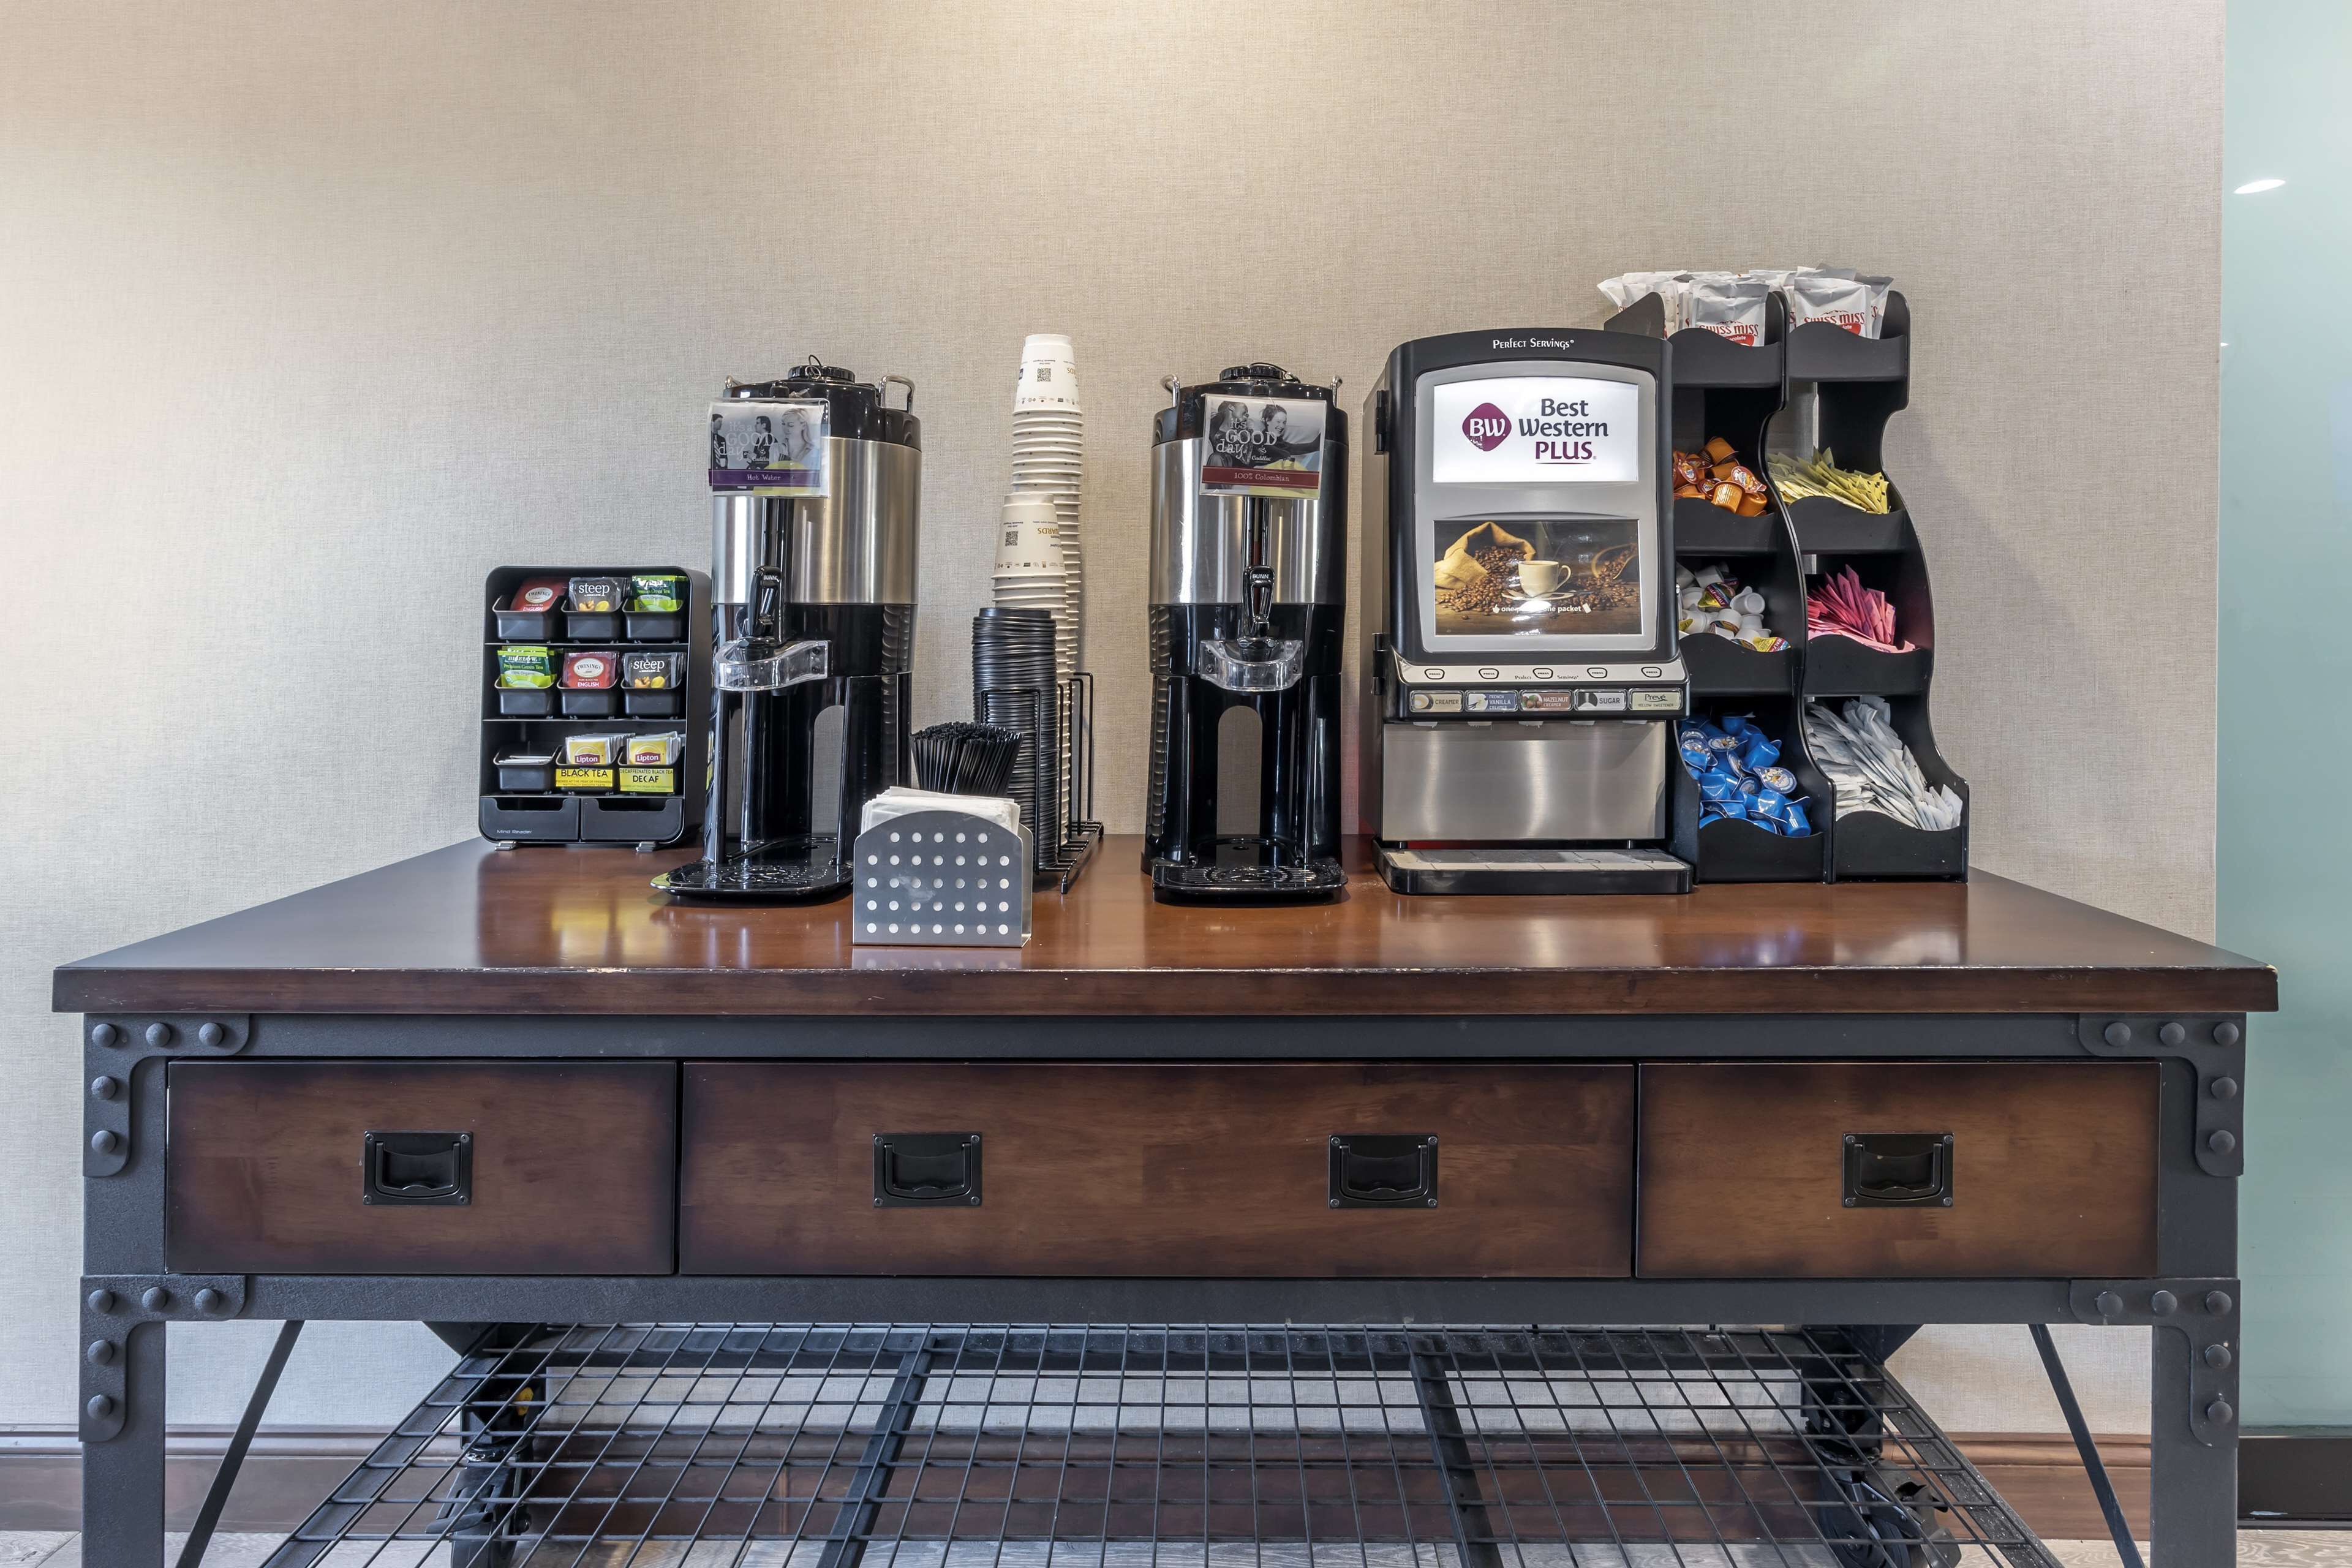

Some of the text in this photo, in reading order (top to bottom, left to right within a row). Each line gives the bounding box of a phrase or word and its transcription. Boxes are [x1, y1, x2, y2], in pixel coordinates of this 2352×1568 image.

[1541, 398, 1589, 417] Best
[1470, 418, 1506, 437] BW
[1518, 418, 1609, 437] Western
[725, 432, 775, 446] GOOD
[1226, 429, 1278, 445] GOOD
[1536, 441, 1593, 459] PLUS
[1255, 473, 1289, 482] Colombian
[578, 582, 610, 597] steep
[633, 659, 665, 673] steep
